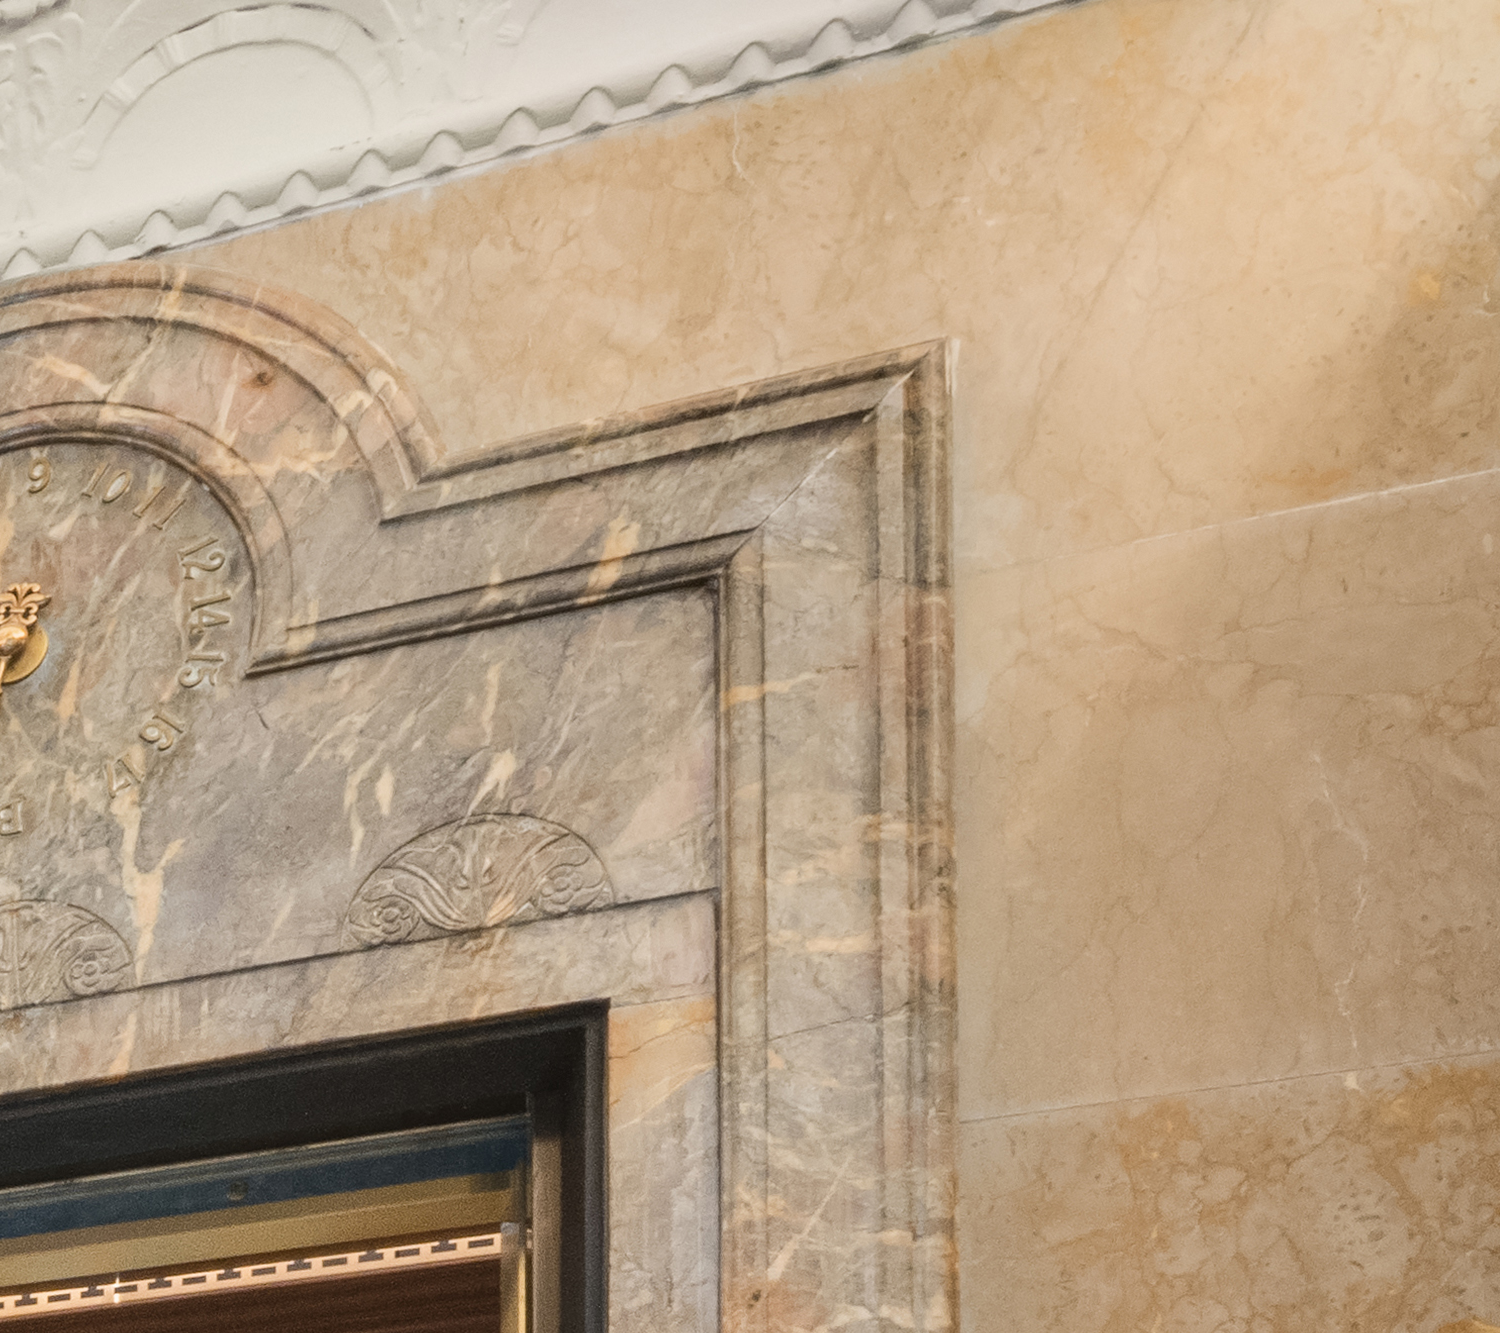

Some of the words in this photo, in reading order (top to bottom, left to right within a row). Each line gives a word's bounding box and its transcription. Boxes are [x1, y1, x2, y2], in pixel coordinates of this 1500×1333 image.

[28, 457, 52, 495] 9
[81, 461, 133, 504] 10
[132, 484, 189, 531] 11
[176, 535, 225, 580] 12
[190, 589, 231, 634] 14
[177, 651, 224, 689] 15
[139, 708, 186, 751] 16
[106, 753, 146, 799] 17
